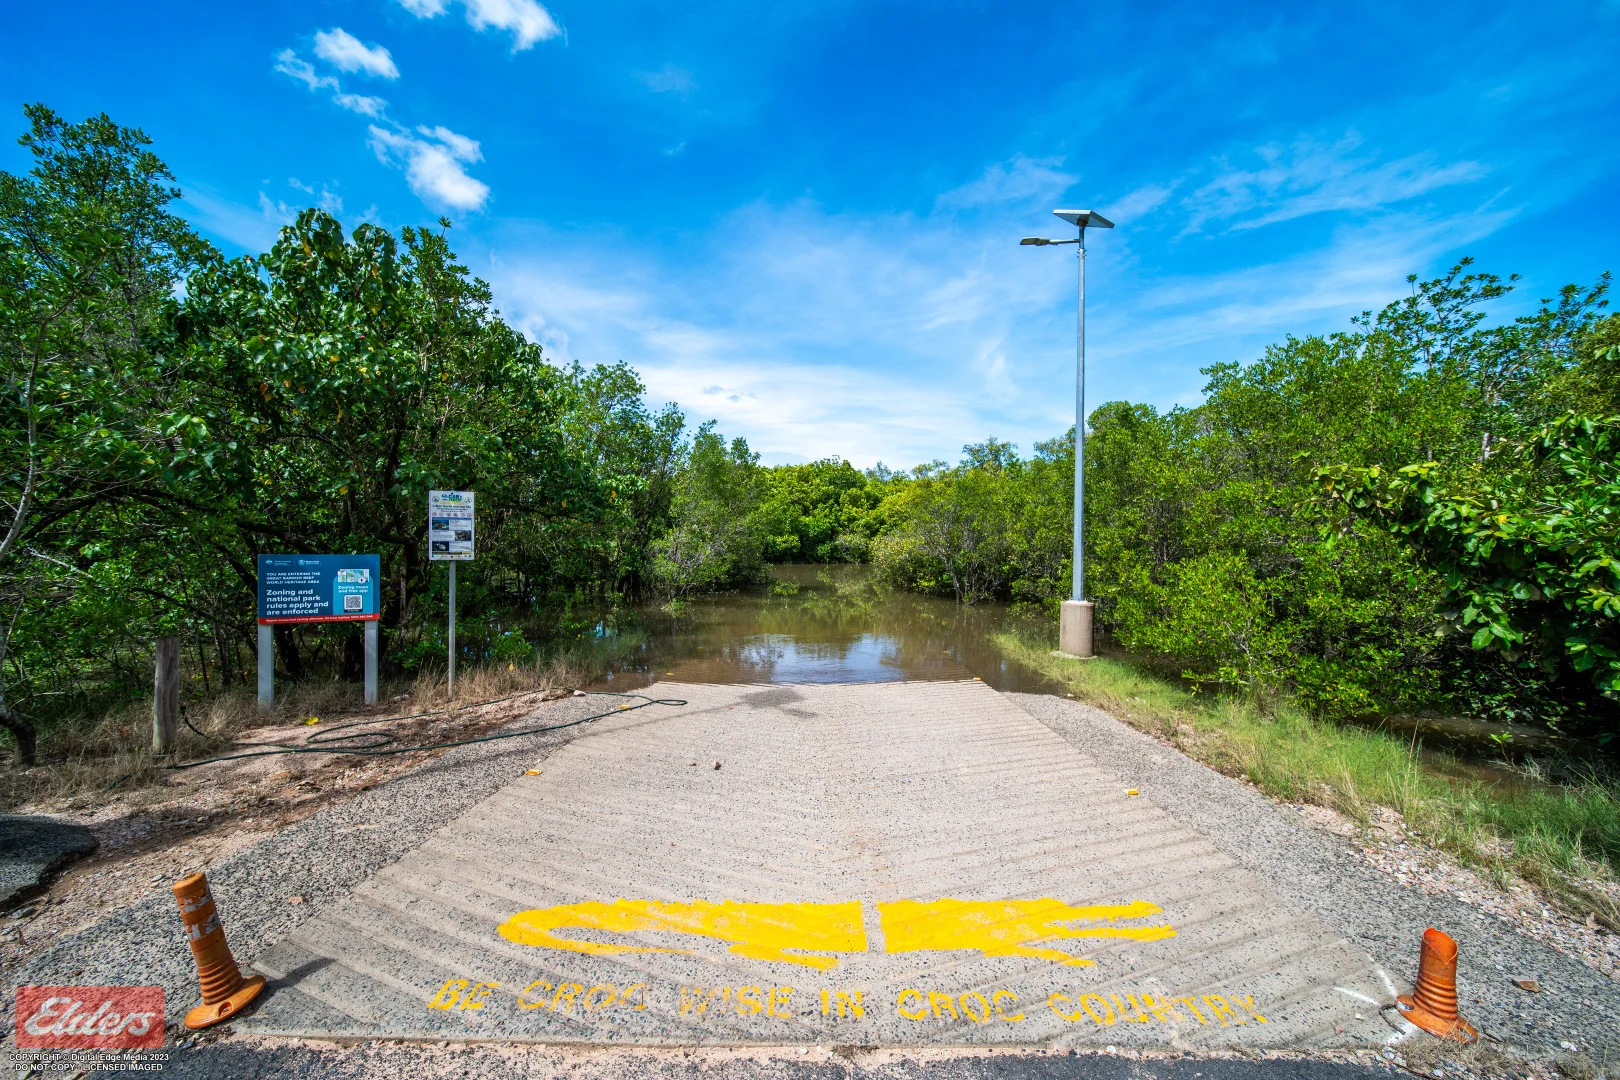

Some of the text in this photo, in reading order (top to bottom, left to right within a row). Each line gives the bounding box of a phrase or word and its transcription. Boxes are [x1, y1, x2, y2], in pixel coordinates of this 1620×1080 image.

[427, 979, 500, 1010] BE
[679, 985, 792, 1019] WISE
[820, 989, 864, 1018] IN
[898, 989, 1024, 1024] CROC
[1047, 992, 1268, 1028] COUNTRY
